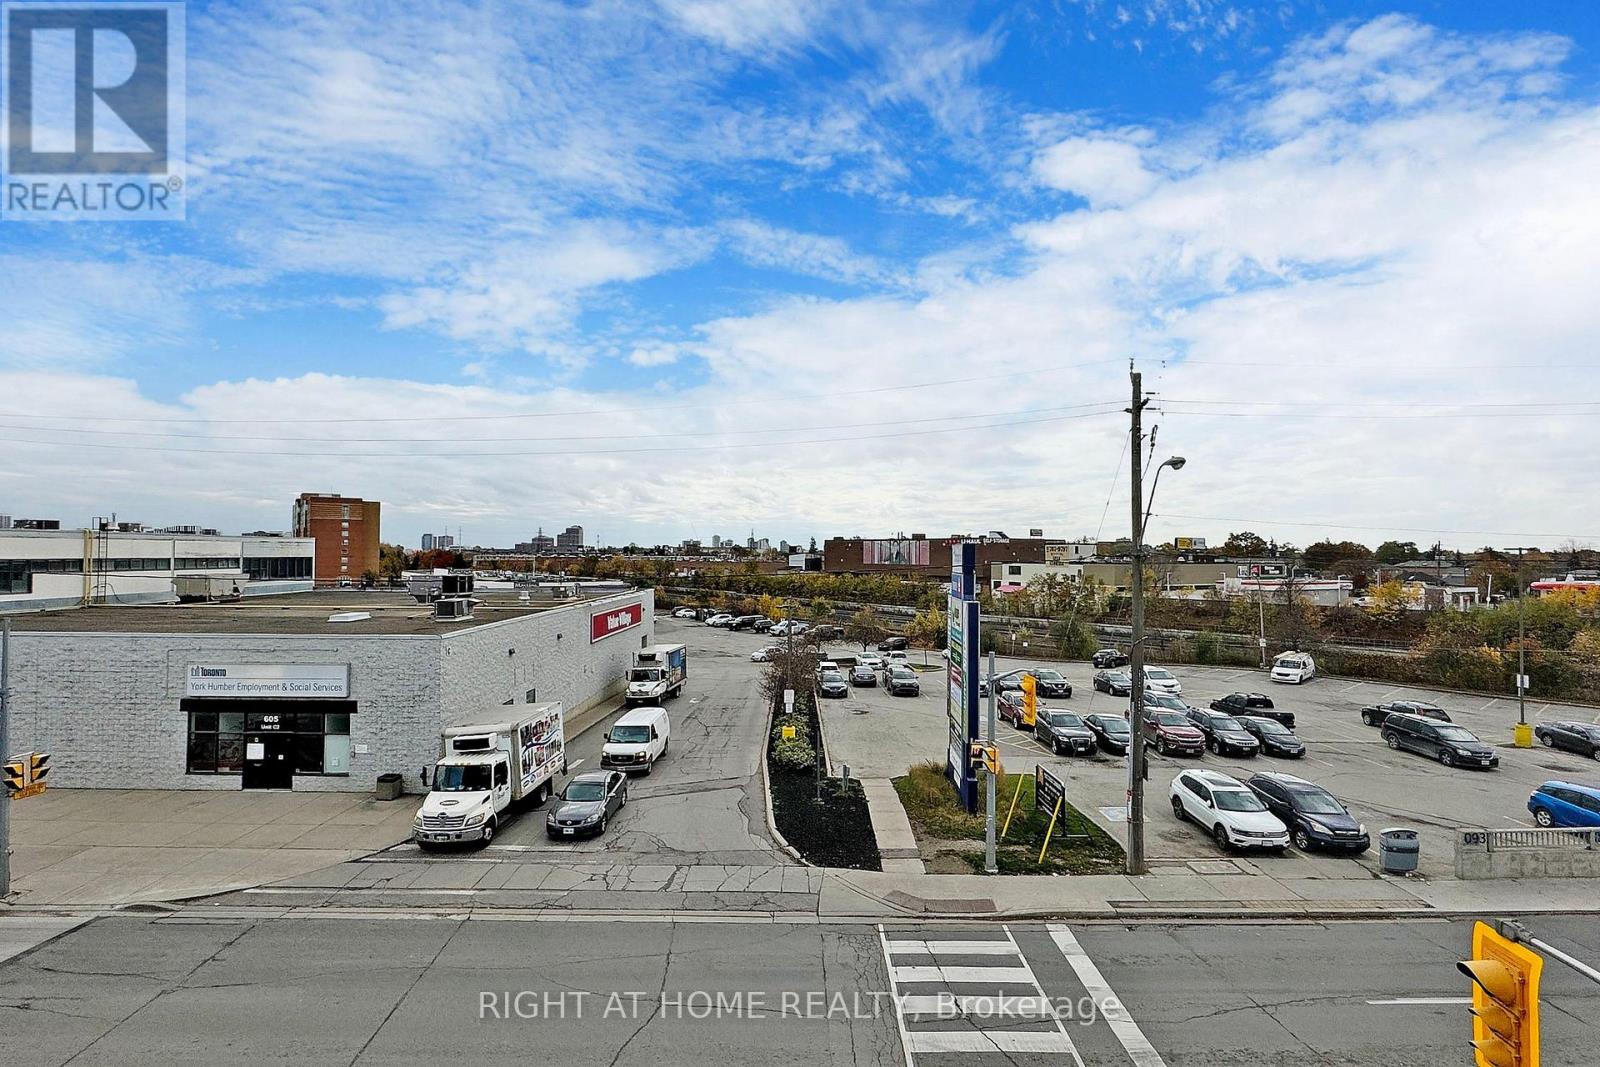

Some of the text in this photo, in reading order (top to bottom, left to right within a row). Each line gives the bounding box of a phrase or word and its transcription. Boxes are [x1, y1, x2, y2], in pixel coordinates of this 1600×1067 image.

[201, 667, 227, 677] TORONTO
[191, 682, 343, 693] York Humber Employment & Social Services
[264, 715, 279, 723] 605
[1464, 832, 1487, 844] 093
